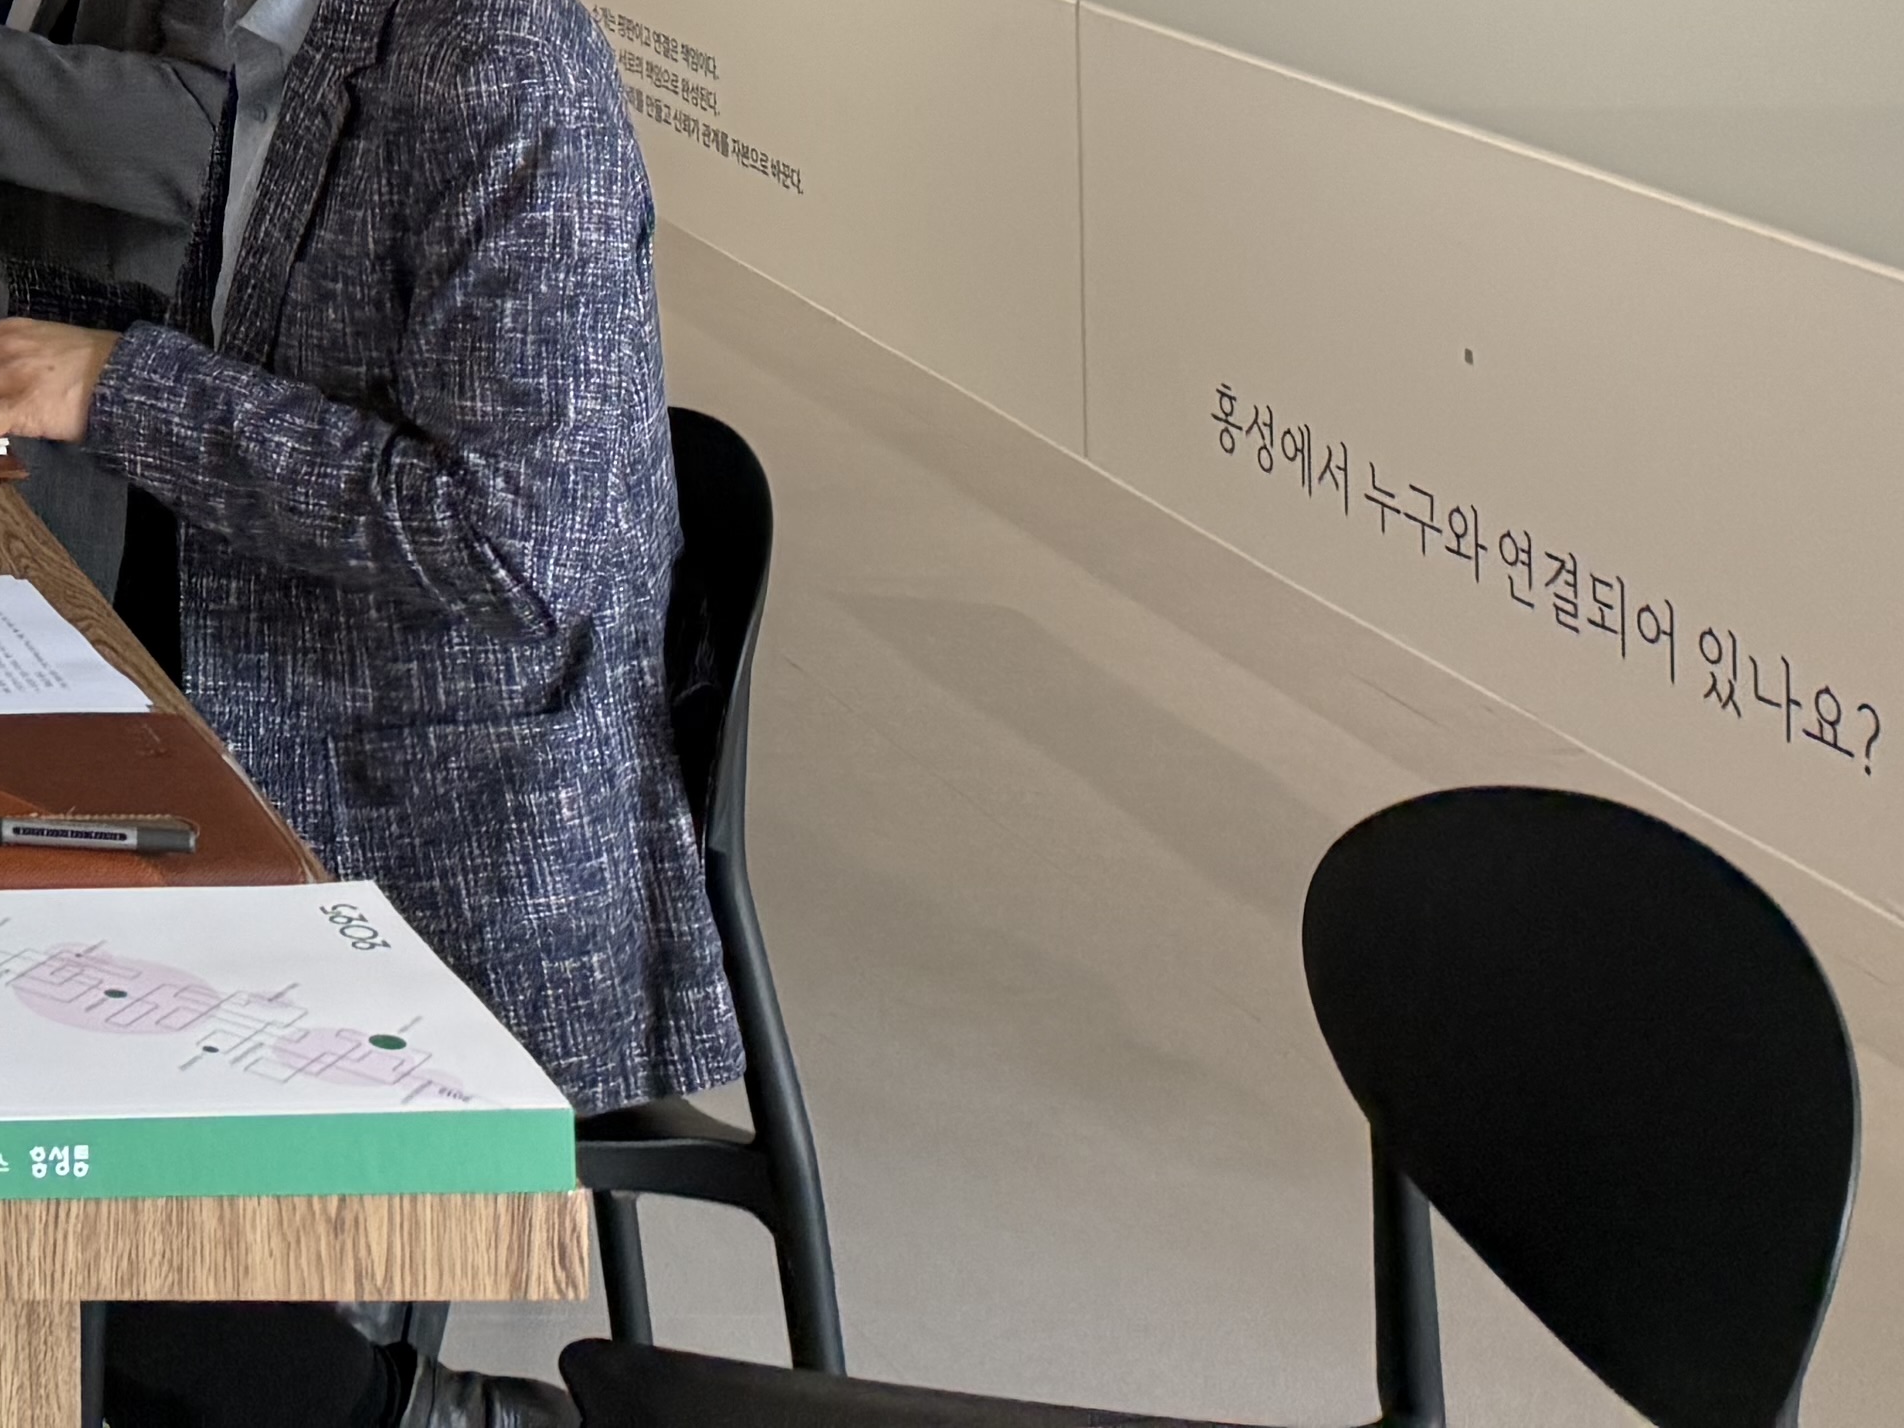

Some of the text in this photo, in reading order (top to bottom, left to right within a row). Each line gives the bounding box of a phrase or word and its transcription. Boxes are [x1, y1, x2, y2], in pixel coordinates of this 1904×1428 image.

[1211, 383, 1882, 776] 홍성에서 누구와 연결되어 있나요?
[319, 903, 391, 951] 2025
[29, 1144, 90, 1179] 홍성통
